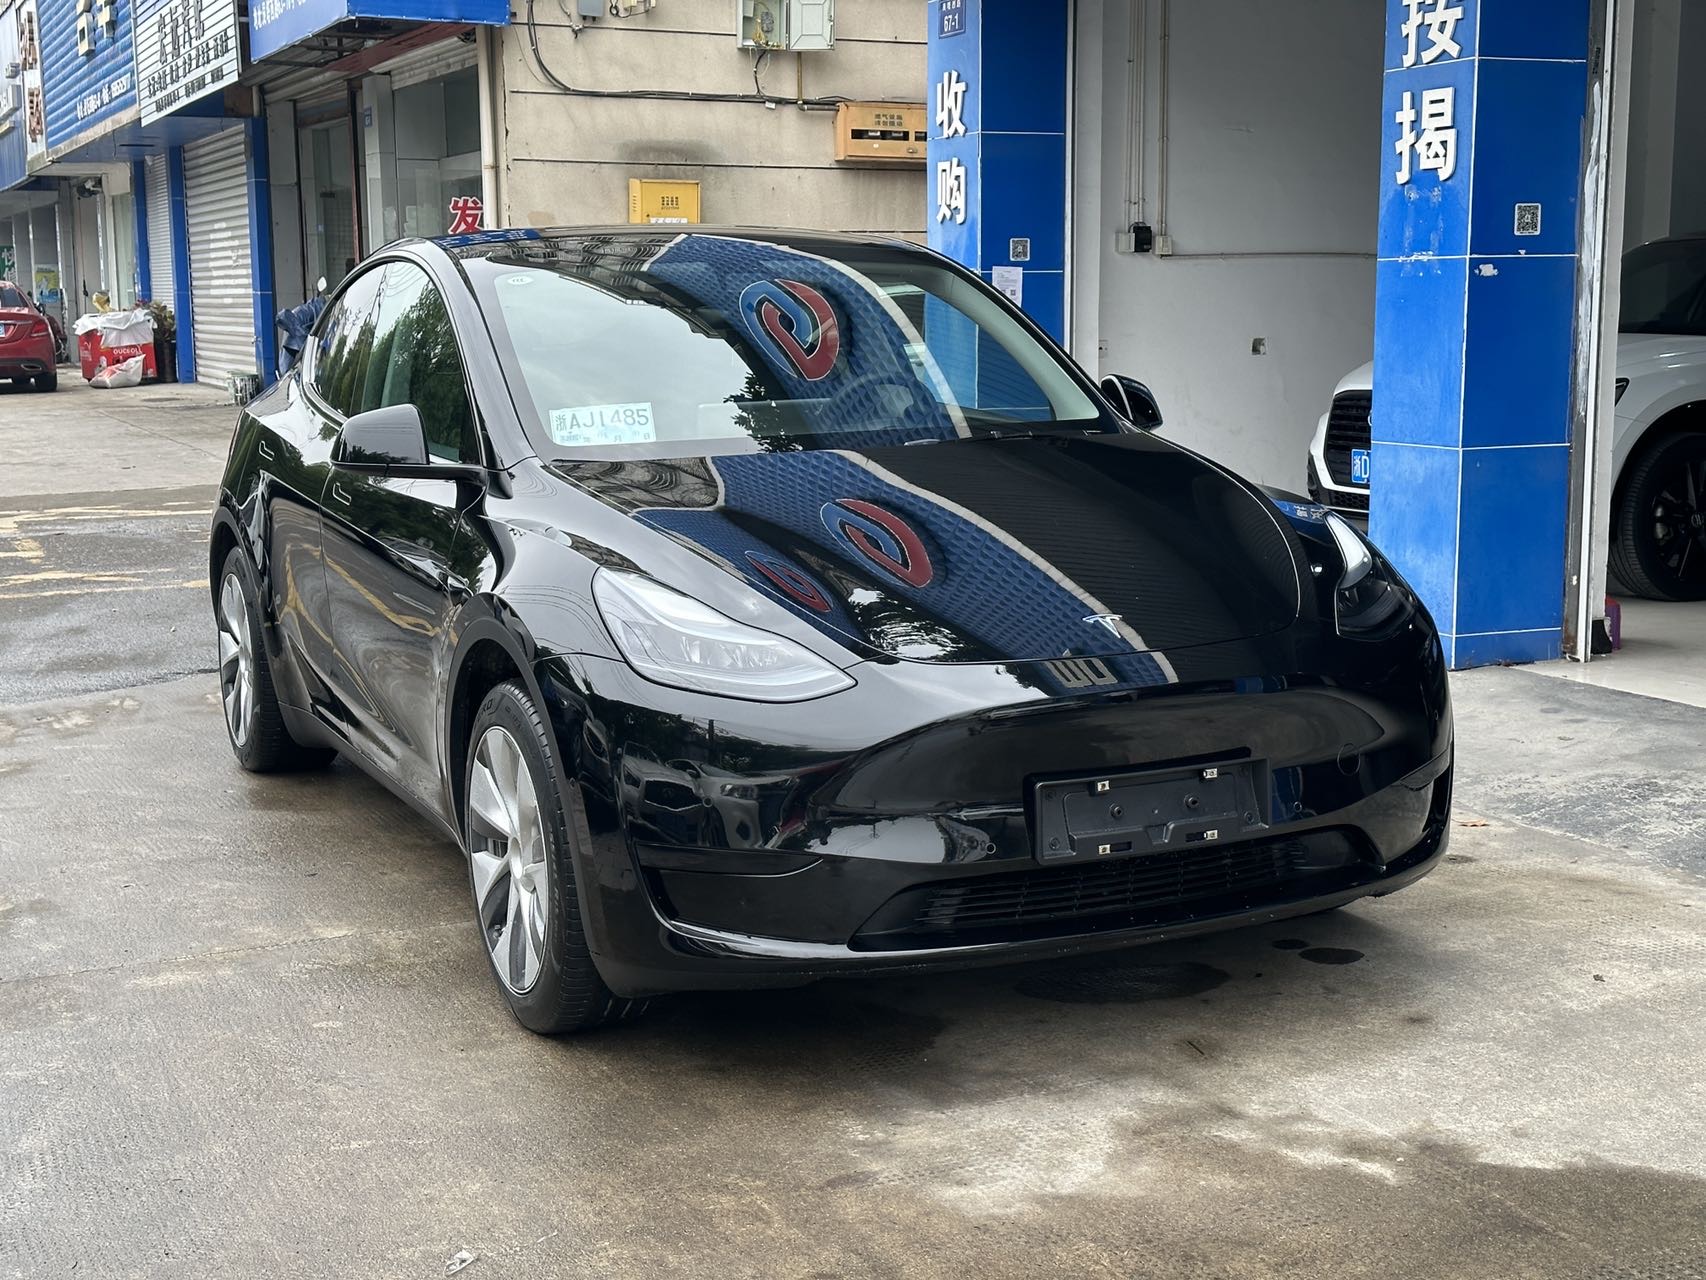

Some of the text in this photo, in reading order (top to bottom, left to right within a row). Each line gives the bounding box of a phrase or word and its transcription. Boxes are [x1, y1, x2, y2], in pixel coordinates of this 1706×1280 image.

[944, 13, 959, 32] 67-1
[1395, 0, 1463, 184] 按揭
[936, 69, 967, 225] 收购
[448, 197, 484, 234] 发
